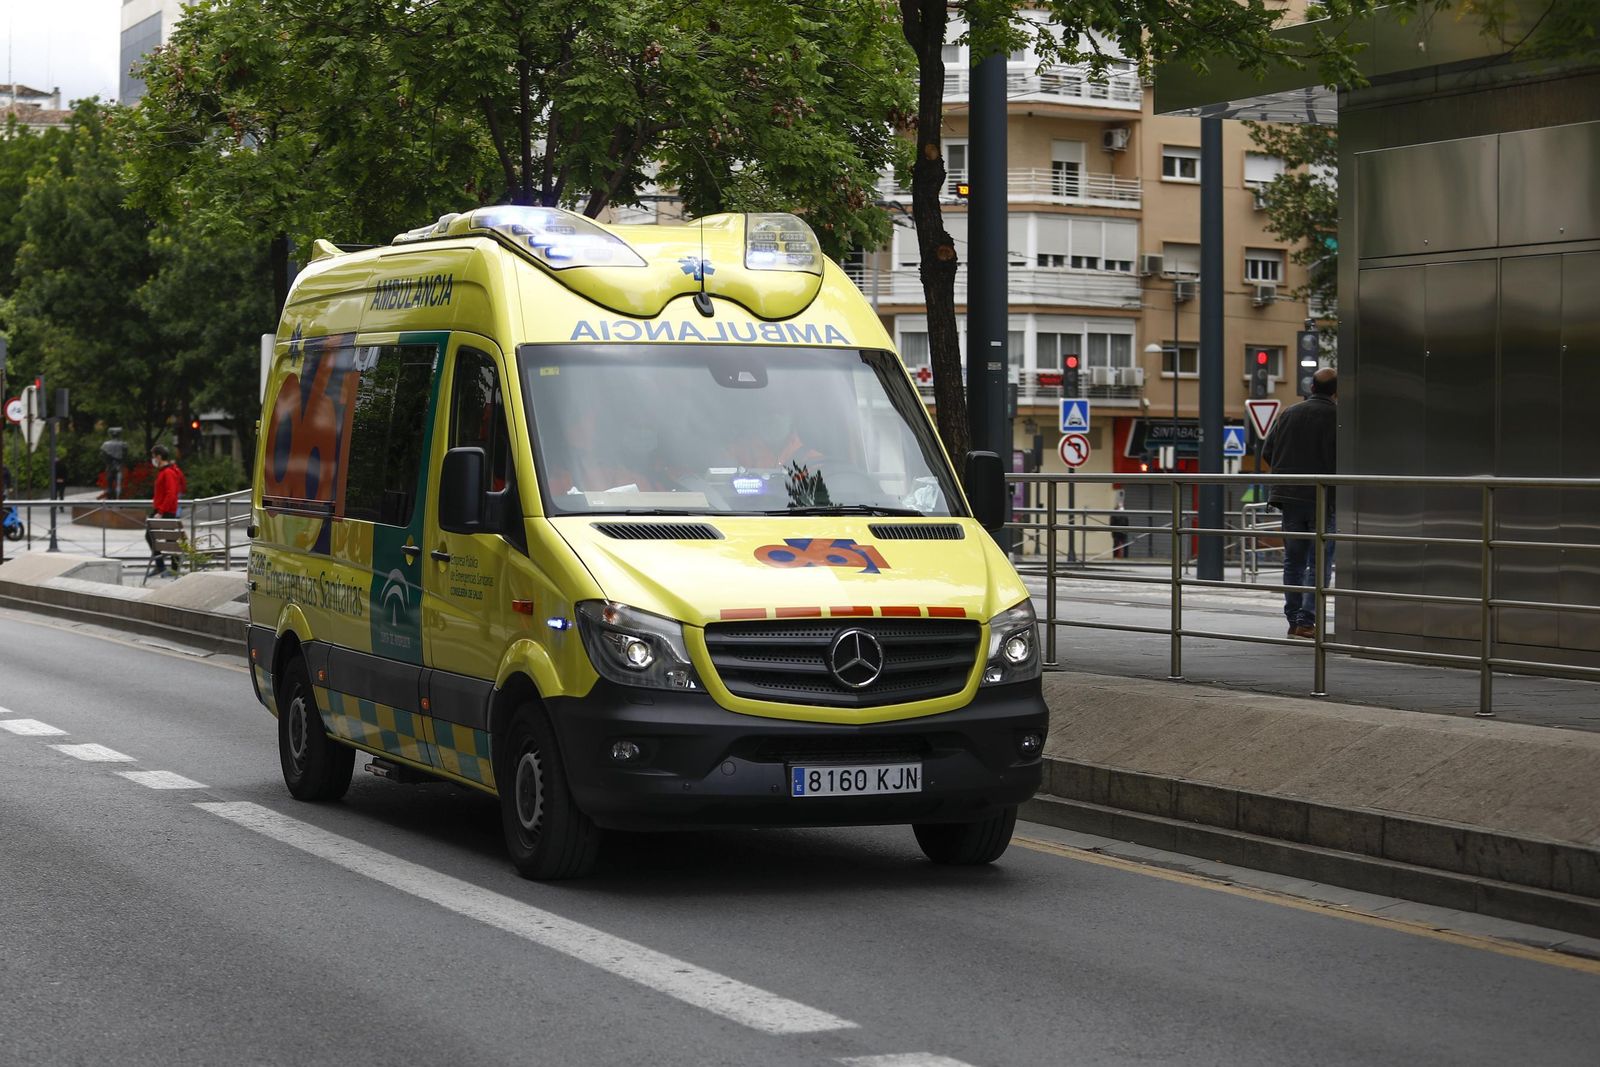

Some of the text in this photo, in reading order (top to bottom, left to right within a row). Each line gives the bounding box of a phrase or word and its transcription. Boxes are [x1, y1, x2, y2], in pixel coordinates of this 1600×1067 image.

[370, 273, 454, 311] AMBULANCIA
[754, 538, 891, 570] 061
[265, 561, 363, 617] Emergencias Sanitarias
[809, 767, 918, 792] 8160 KJN
